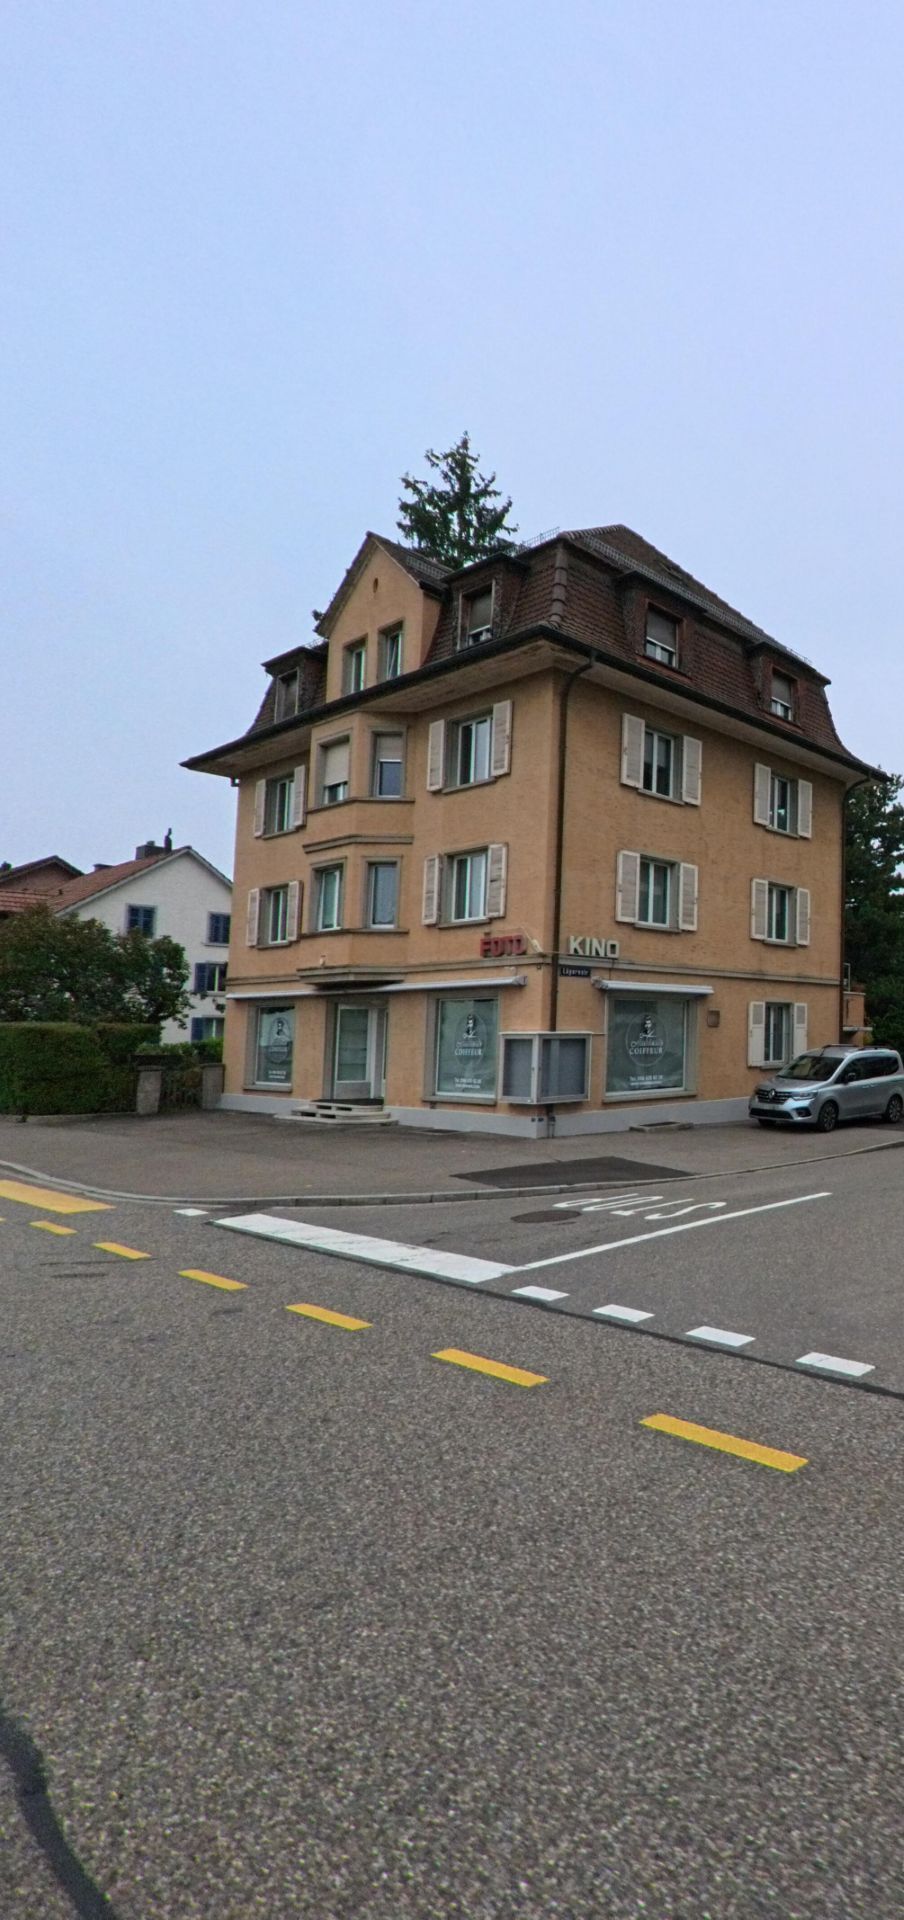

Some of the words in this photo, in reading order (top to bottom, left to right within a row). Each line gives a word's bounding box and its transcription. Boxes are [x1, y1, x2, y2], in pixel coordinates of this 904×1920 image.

[480, 934, 526, 957] FOTO
[569, 935, 619, 958] KINO
[552, 1193, 727, 1220] STOP
